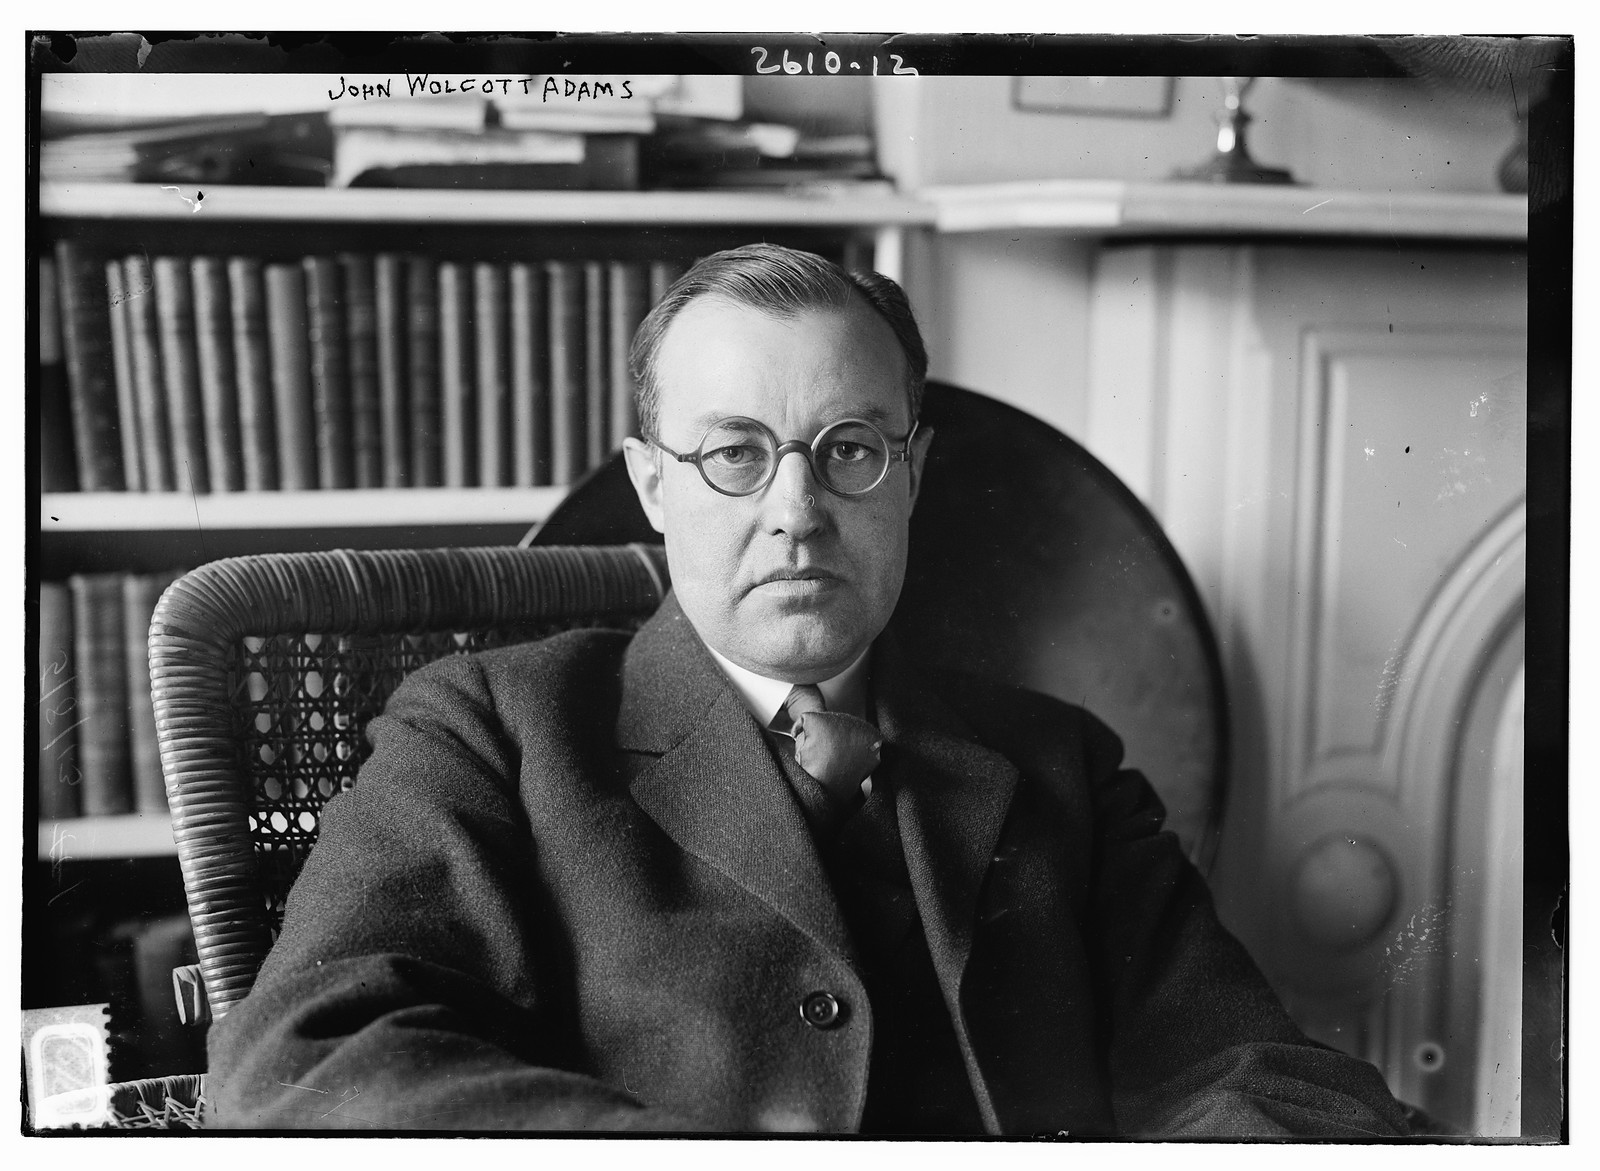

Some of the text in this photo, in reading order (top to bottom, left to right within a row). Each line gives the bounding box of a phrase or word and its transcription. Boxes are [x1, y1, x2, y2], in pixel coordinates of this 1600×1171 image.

[750, 46, 919, 77] 2610-12
[328, 73, 633, 102] JOHN WOLCOTT ADAMS
